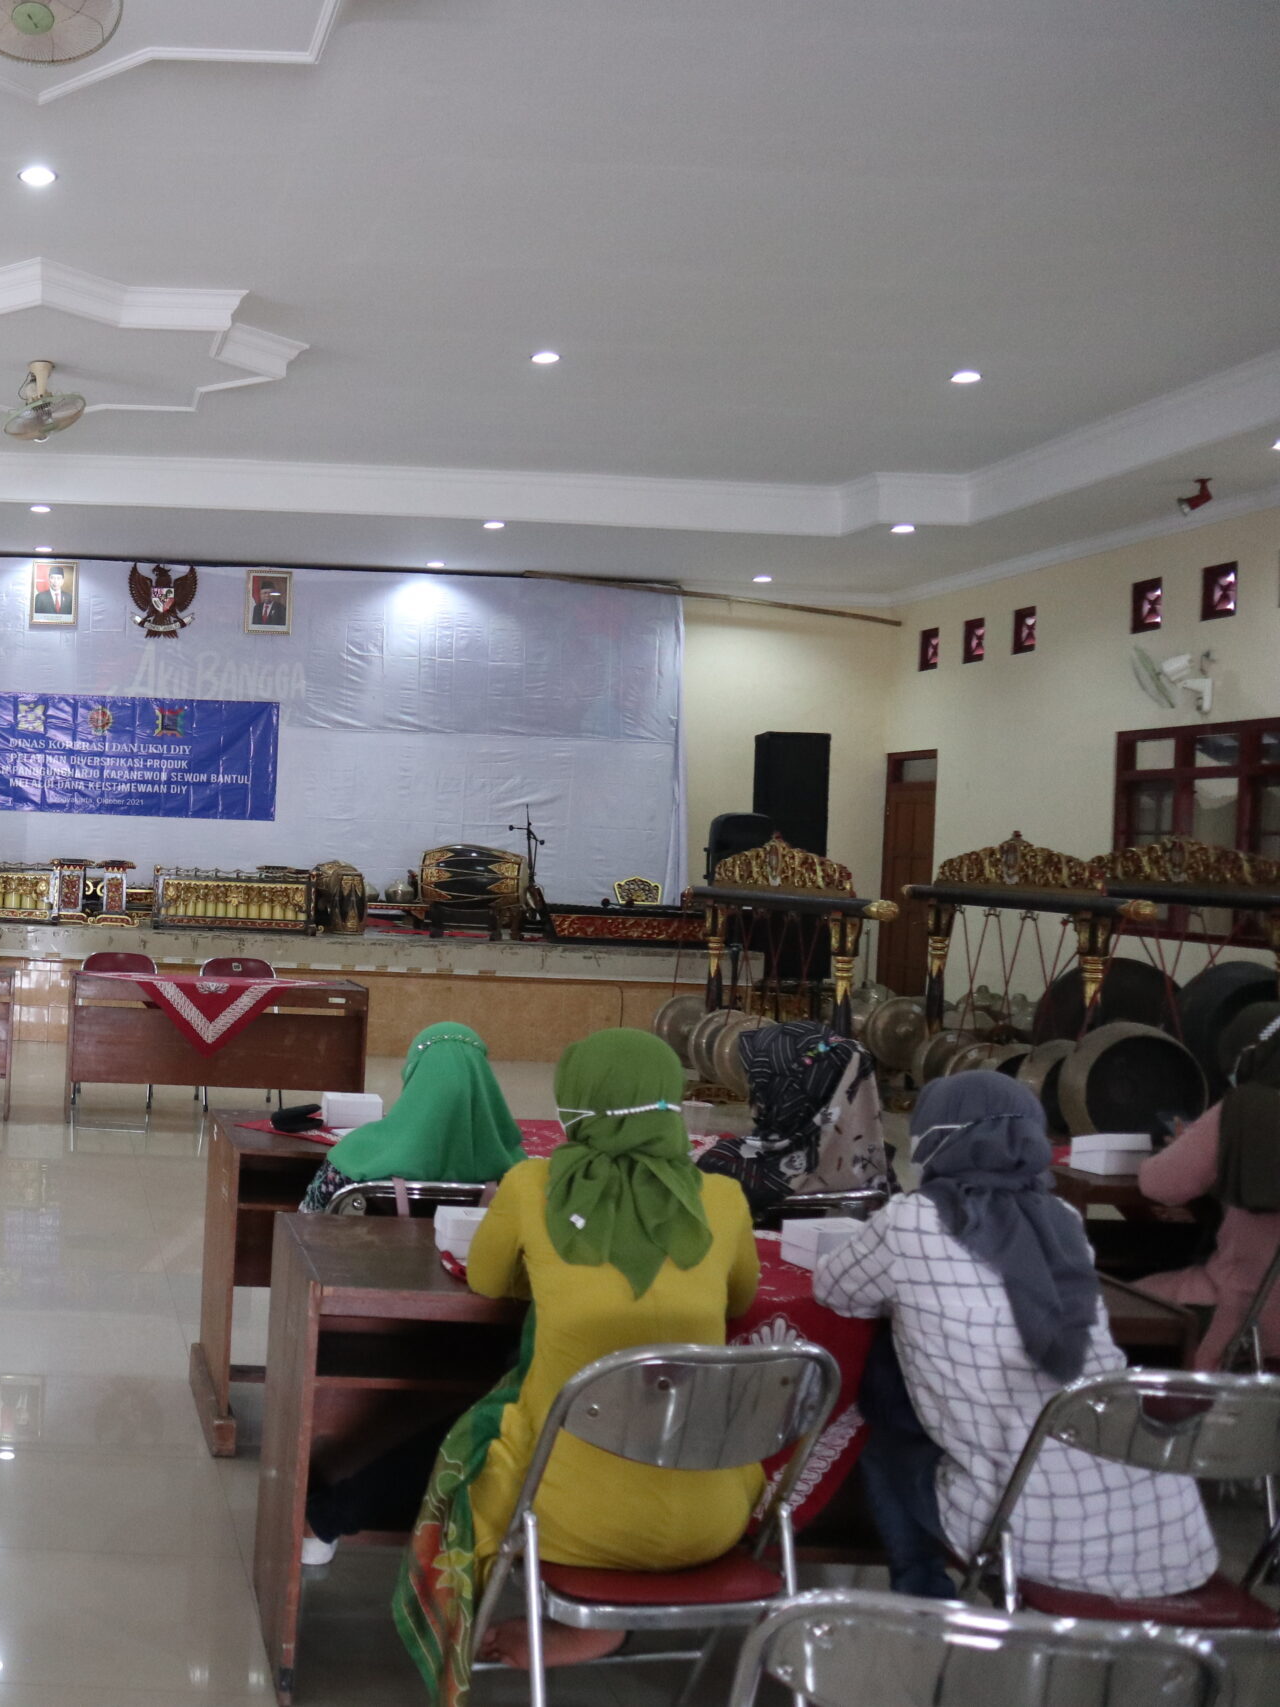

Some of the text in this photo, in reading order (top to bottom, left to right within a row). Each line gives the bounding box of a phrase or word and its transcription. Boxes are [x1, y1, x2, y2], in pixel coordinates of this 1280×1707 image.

[8, 737, 191, 755] DINAS KOPERASI DAN UKM DIY
[10, 752, 188, 769] PELATIHAN DIVERSIFIKASI PRODUK
[103, 769, 167, 781] KAPANEWON
[170, 771, 207, 783] SEWON
[210, 773, 250, 784] BANTUL
[57, 779, 85, 790] DANA
[88, 780, 167, 793] KEISTIMEWAAN
[170, 784, 187, 794] DIY
[126, 798, 144, 806] 2021
